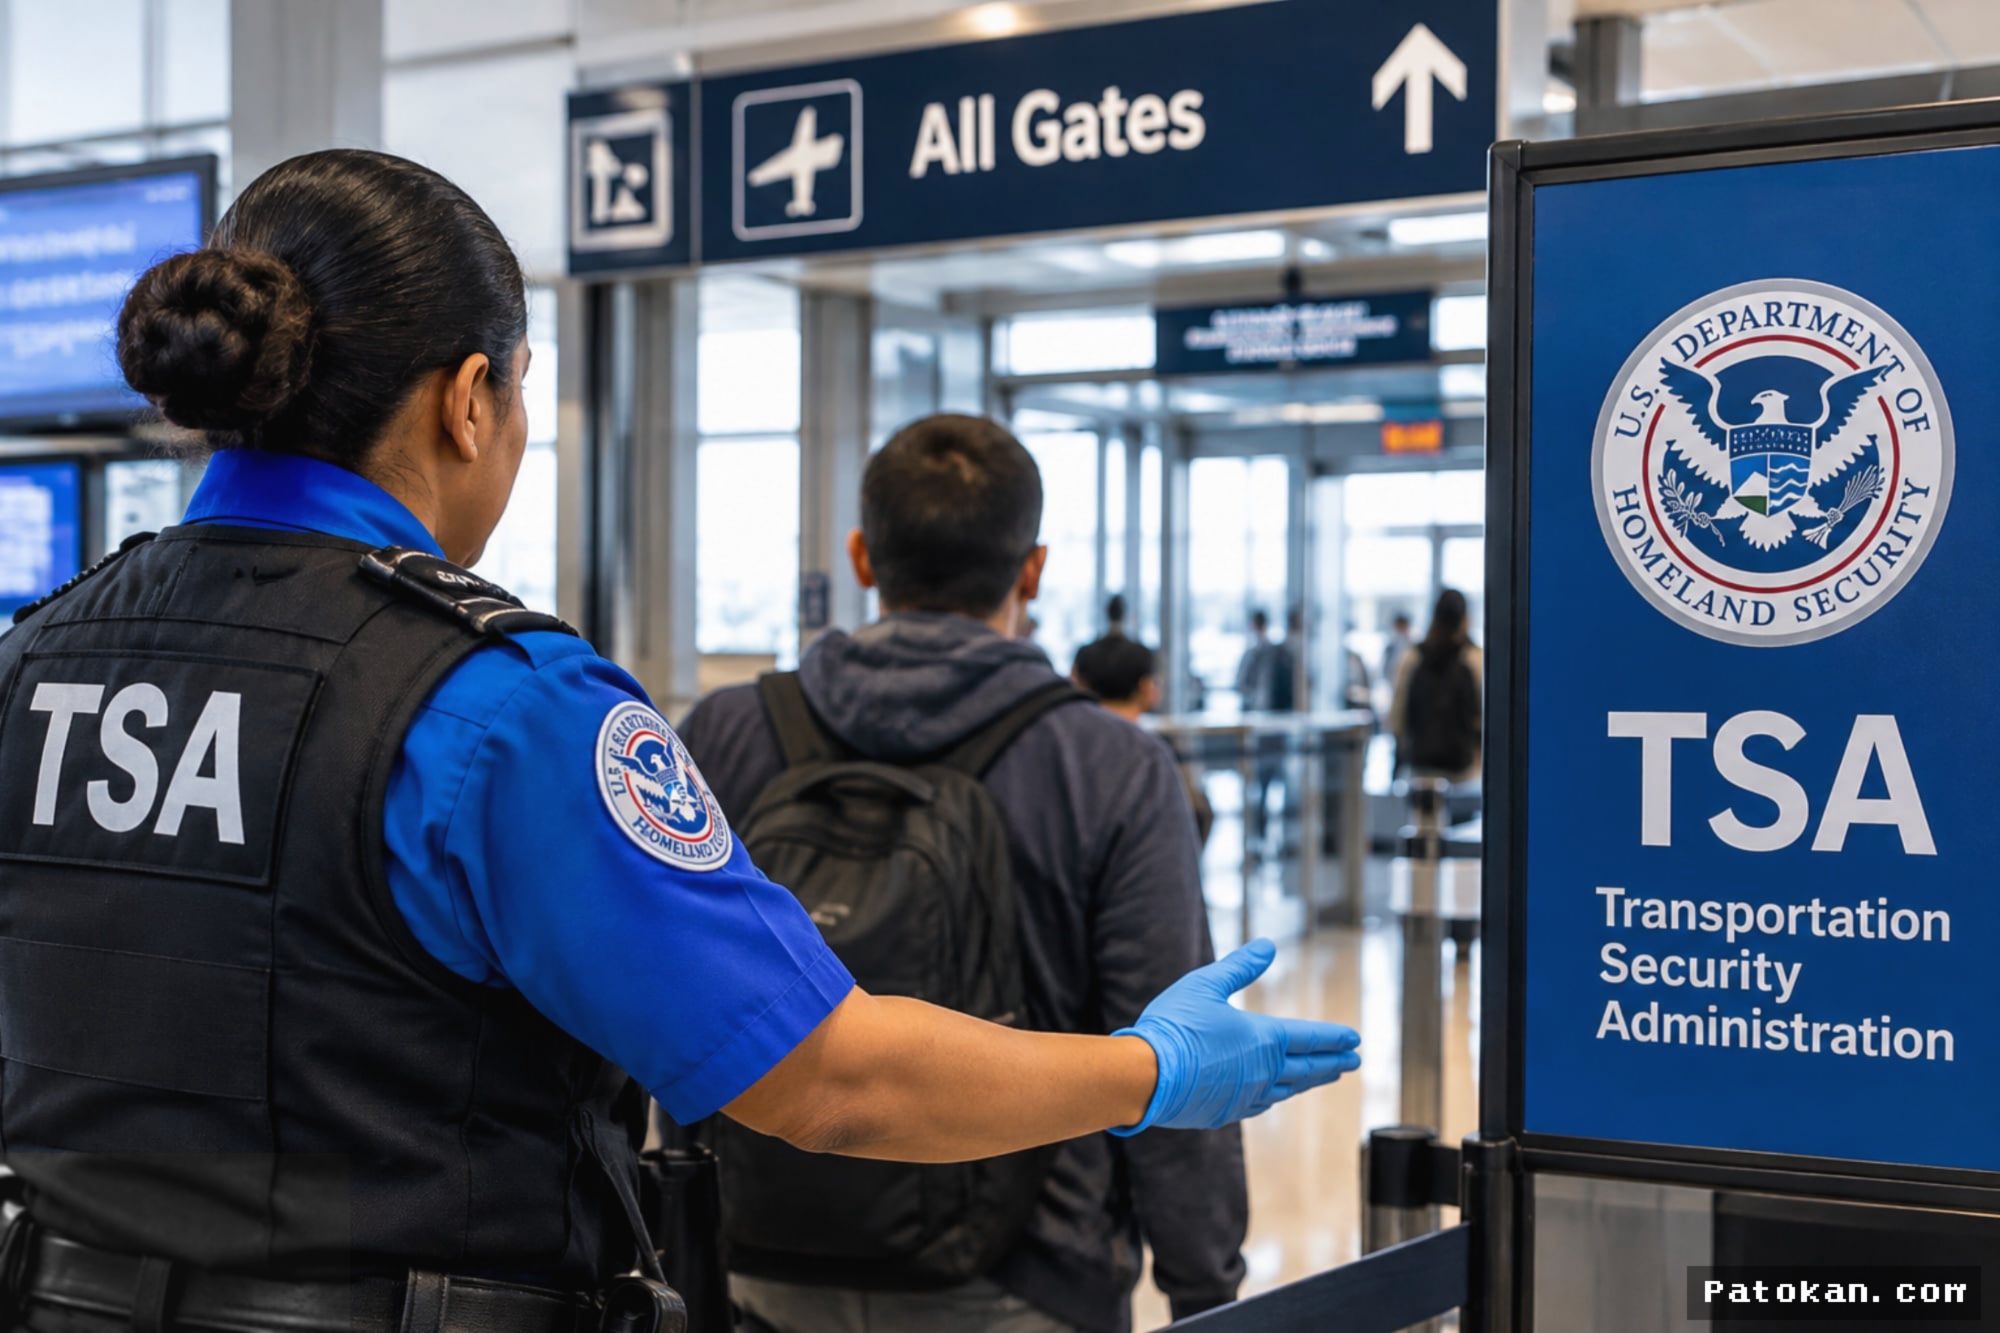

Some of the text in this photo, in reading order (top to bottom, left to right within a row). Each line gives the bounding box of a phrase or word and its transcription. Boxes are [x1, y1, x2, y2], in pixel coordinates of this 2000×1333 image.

[909, 85, 1206, 179] All Gates
[1613, 300, 1931, 439] U.S. DEPARTMENT OF
[1612, 477, 1931, 627] HOMELAND SECURITY
[29, 682, 245, 845] TSA
[1607, 710, 1938, 856] TSA
[1595, 886, 1951, 943] Transportation
[1595, 1000, 1955, 1062] Administration
[1600, 942, 1803, 1004] Security
